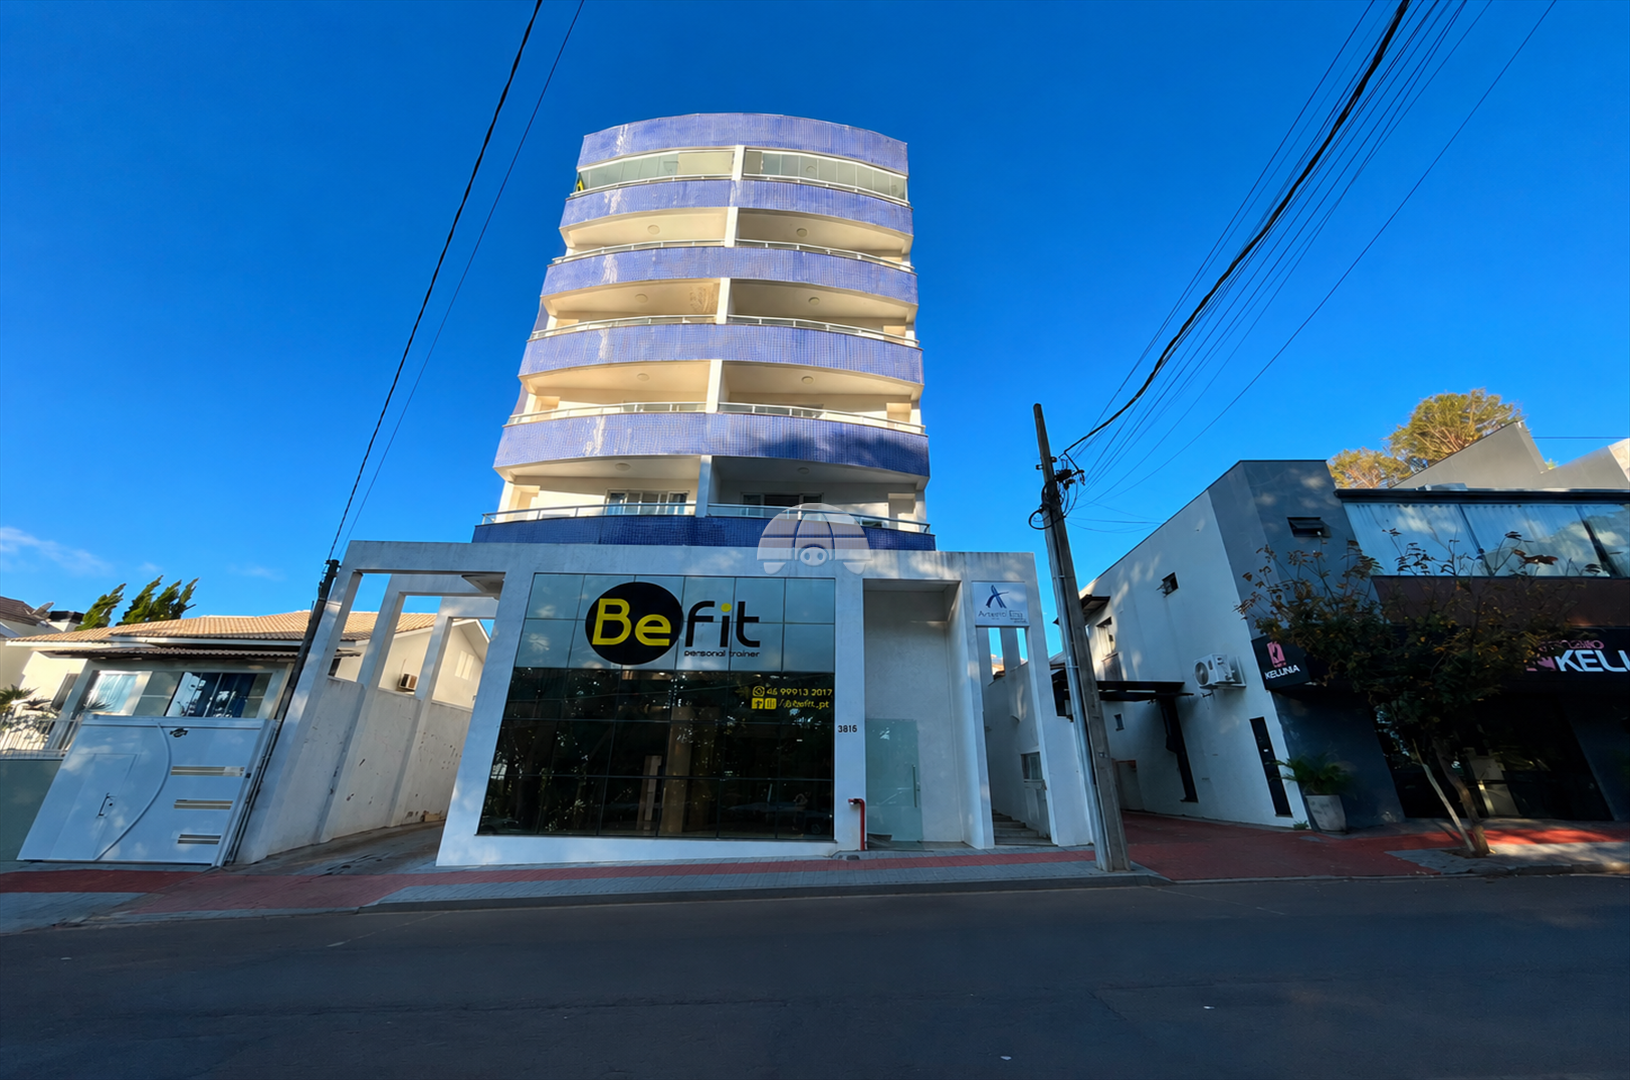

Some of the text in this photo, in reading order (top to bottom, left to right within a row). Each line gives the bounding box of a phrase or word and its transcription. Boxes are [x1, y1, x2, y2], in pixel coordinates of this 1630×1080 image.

[729, 650, 760, 658] trainer
[780, 688, 809, 696] 99913
[811, 688, 833, 696] 2017
